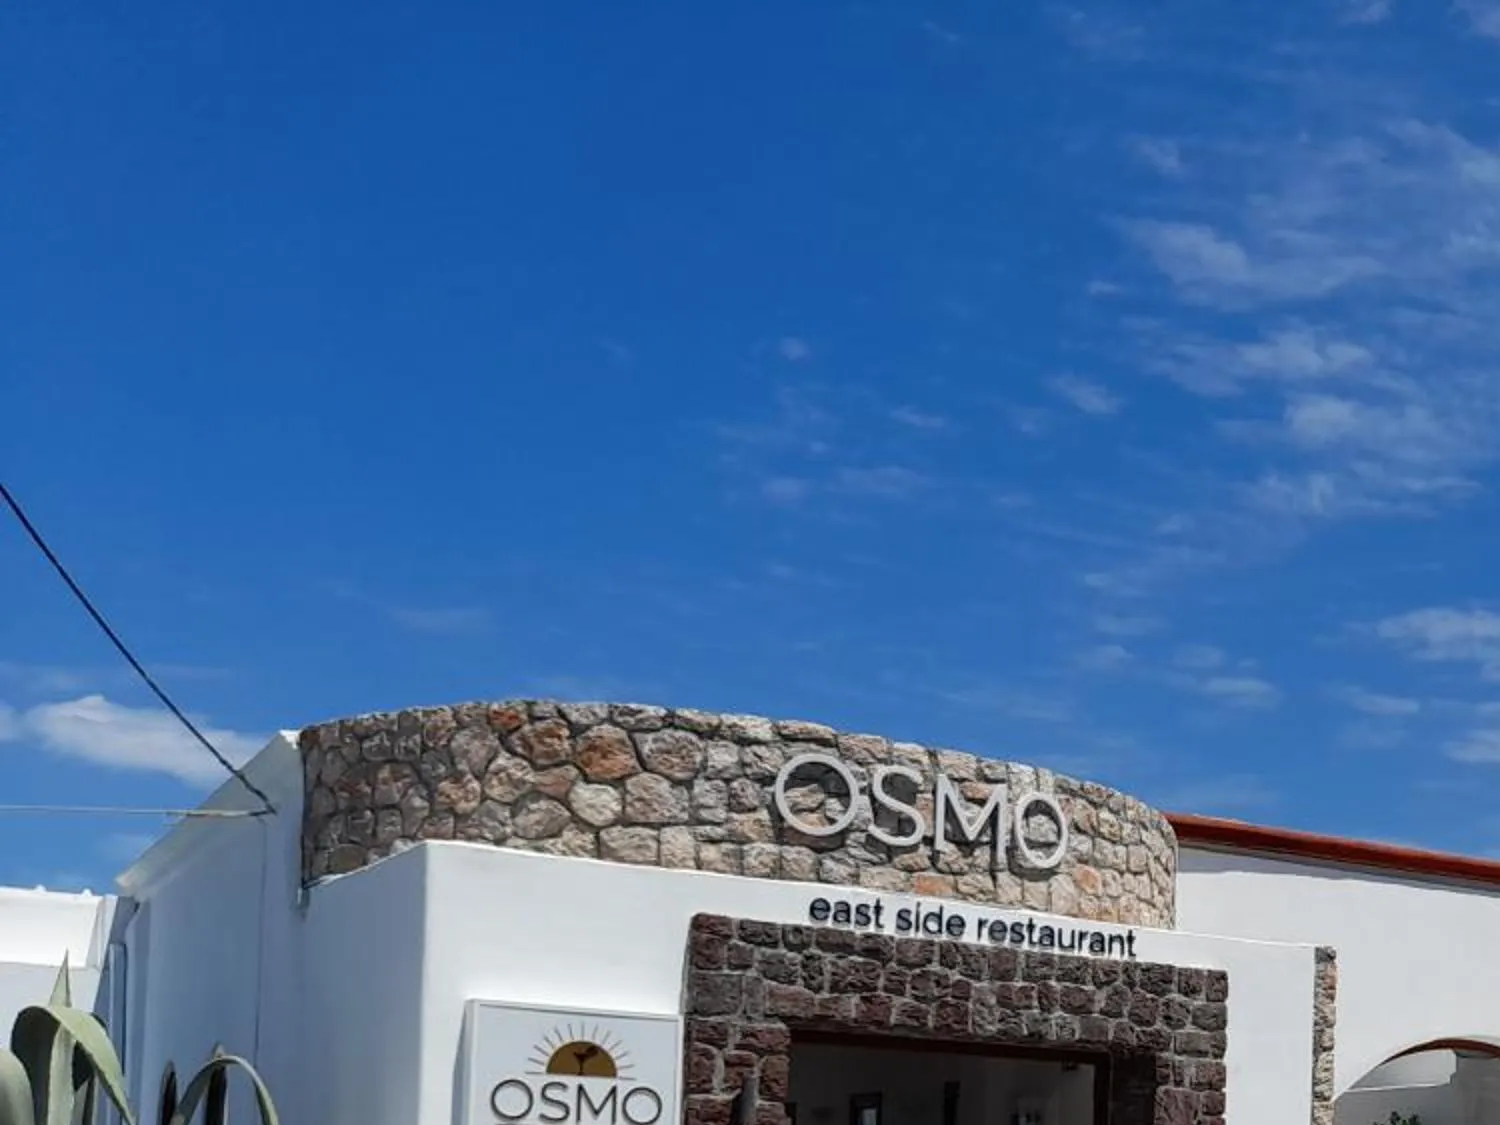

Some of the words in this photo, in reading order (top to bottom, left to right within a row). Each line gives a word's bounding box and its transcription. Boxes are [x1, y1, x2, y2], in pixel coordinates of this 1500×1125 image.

[775, 754, 1068, 869] OSMO
[809, 897, 883, 928] east
[896, 901, 966, 937] side
[977, 917, 1136, 957] restaurant
